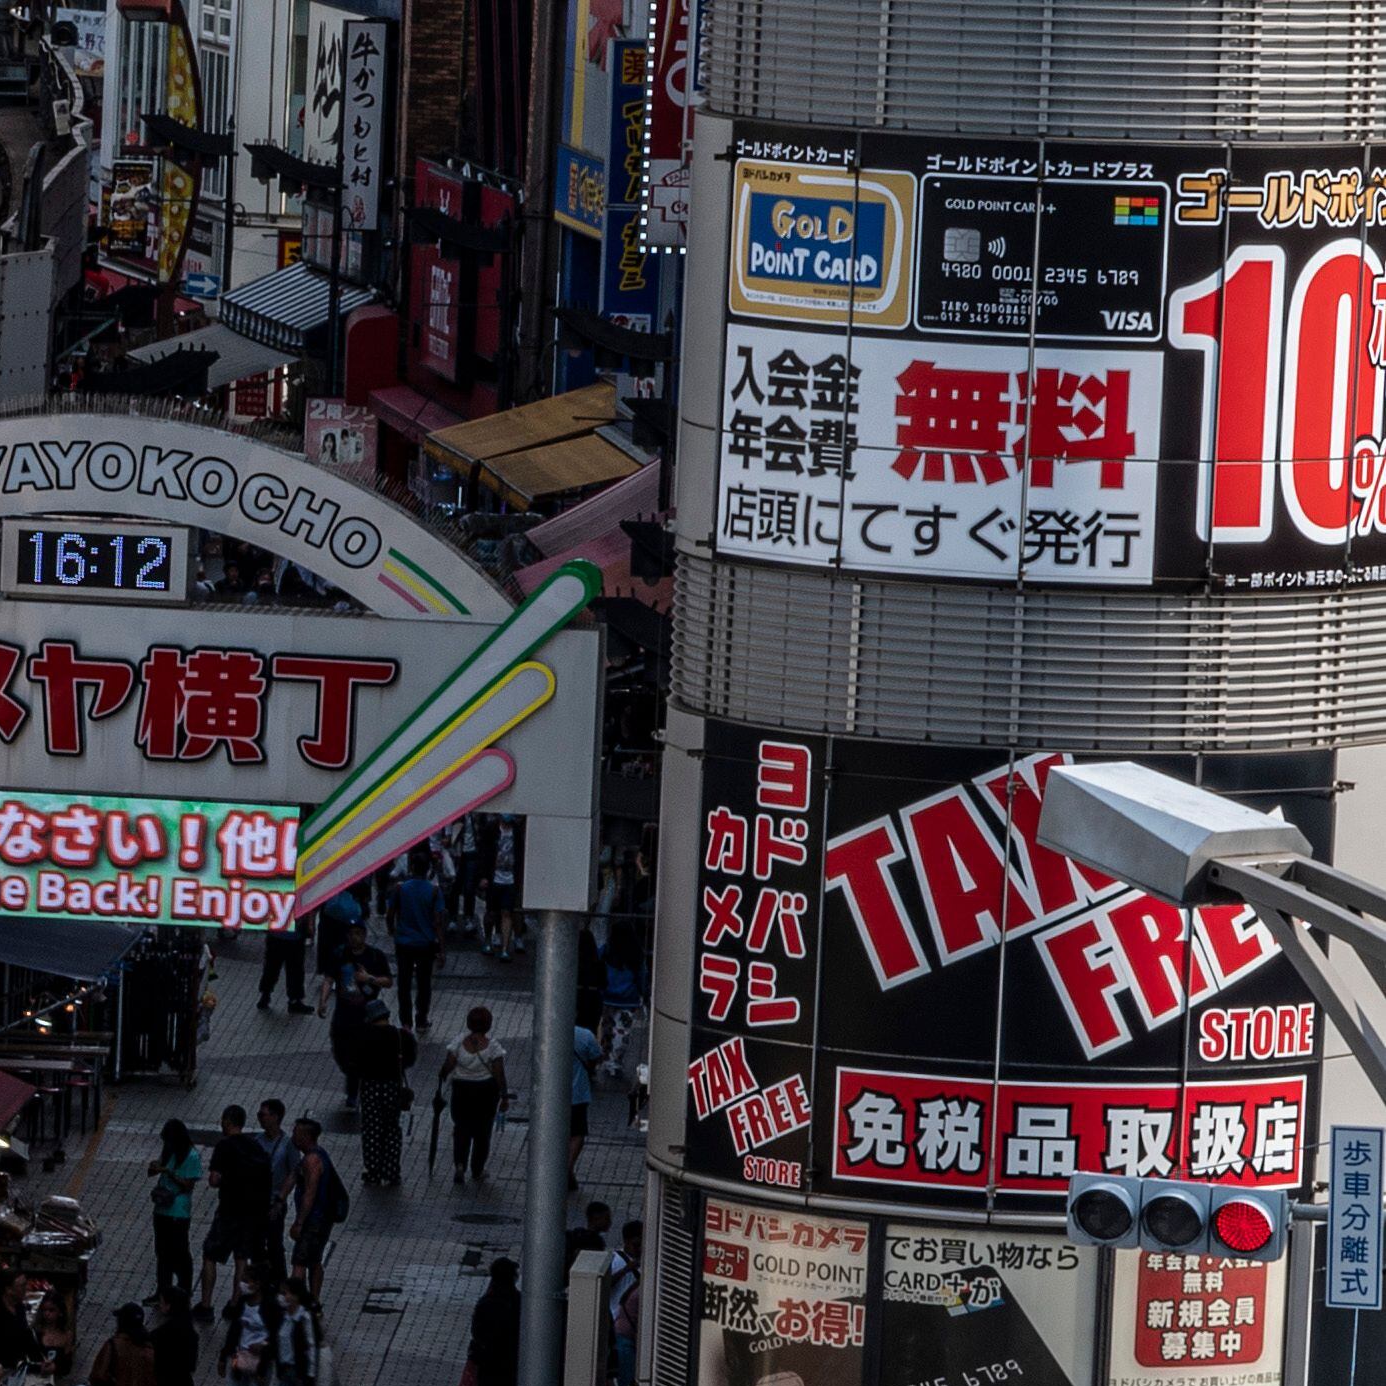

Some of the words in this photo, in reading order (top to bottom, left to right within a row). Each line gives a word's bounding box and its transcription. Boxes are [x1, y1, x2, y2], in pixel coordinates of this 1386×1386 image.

[350, 32, 380, 187] 牛かつもと村
[736, 139, 856, 164] ゴールドポイントカード
[926, 153, 1155, 180] ゴールドポイントカードプラス
[772, 199, 856, 245] GOLD
[944, 198, 975, 212] GOLD
[975, 199, 1013, 213] POINT
[750, 240, 811, 276] POINT
[814, 247, 878, 283] CARD
[941, 261, 982, 280] 4980
[991, 264, 1034, 283] 0001
[1044, 267, 1088, 285] 2345
[1099, 309, 1153, 332] VISA
[729, 345, 863, 416] 入会金
[1167, 237, 1383, 544] 10
[727, 408, 859, 483] 年会費
[890, 359, 1137, 490] 無料
[722, 483, 1143, 570] 店頭にてすぐ発行
[26, 528, 169, 590] 16:12
[37, 871, 161, 916] Back!
[171, 877, 297, 931] Enjoy
[746, 738, 812, 1028] ヨドバシ
[699, 805, 750, 1024] カメラ
[1198, 1002, 1316, 1063] STORE
[687, 1036, 760, 1121] TAX
[725, 1072, 812, 1158] FREE
[843, 1090, 1302, 1179] 免税品取扱店
[742, 1154, 803, 1190] STORE
[704, 1203, 868, 1255] ヨドバシカメラ
[886, 1235, 1081, 1271] でお買い物なら
[1340, 1140, 1373, 1297] 歩車分離式
[714, 1262, 734, 1277] より
[753, 1253, 801, 1277] GOLD
[806, 1260, 865, 1286] POINT
[884, 1269, 942, 1292] CARD
[970, 1277, 1003, 1307] が
[1183, 1270, 1225, 1295] 無料
[1146, 1295, 1256, 1330] 新規会員
[1160, 1329, 1243, 1361] 募集中
